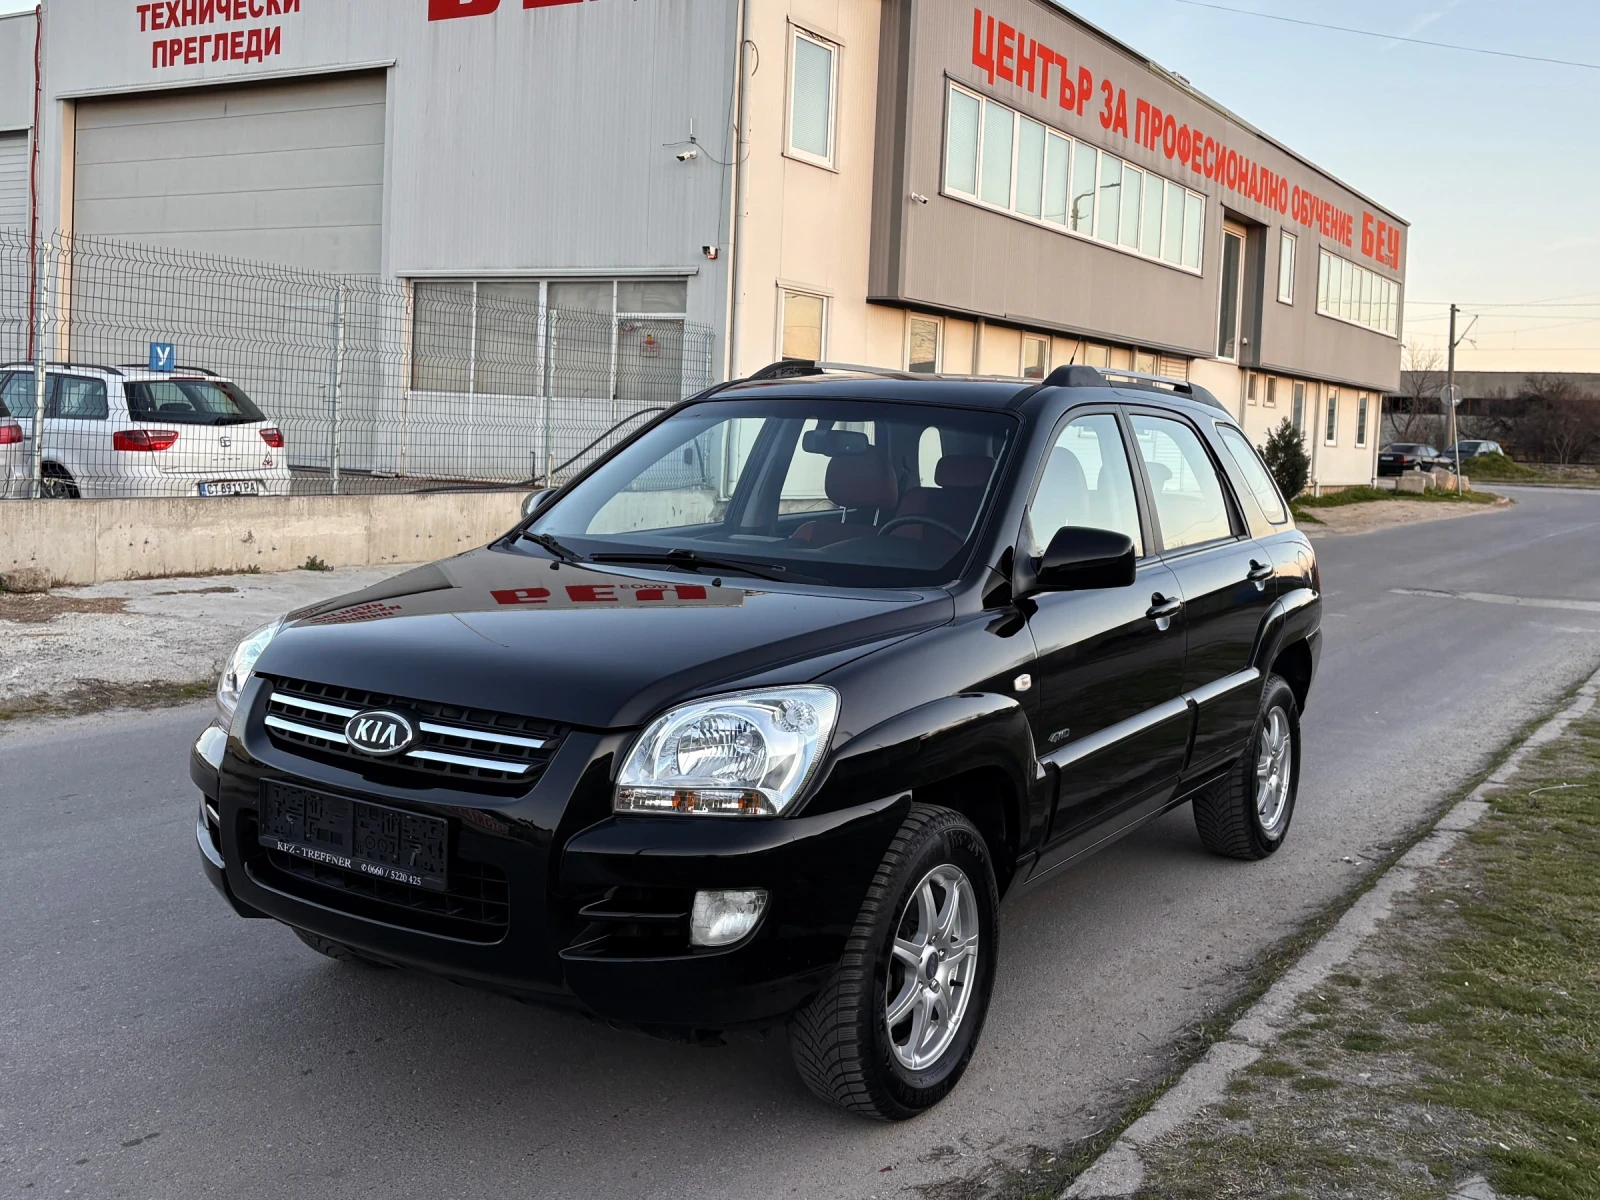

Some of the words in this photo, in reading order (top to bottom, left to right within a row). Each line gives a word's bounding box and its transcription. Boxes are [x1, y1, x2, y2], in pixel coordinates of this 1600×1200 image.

[152, 26, 281, 68] ПРЕГЛЕДИ
[972, 8, 1093, 117] ЦЕНТЪР
[1099, 79, 1128, 138] ЗА
[1135, 98, 1288, 215] ПРОФЕСИОНАЛНО
[1292, 185, 1353, 248] ОБУЧЕНИЕ
[1361, 211, 1400, 270] БЕЧ
[354, 718, 397, 747] KIA
[277, 841, 295, 854] KFZ
[301, 847, 351, 868] TREFFNER
[390, 870, 407, 882] 5220
[409, 875, 421, 885] 425
